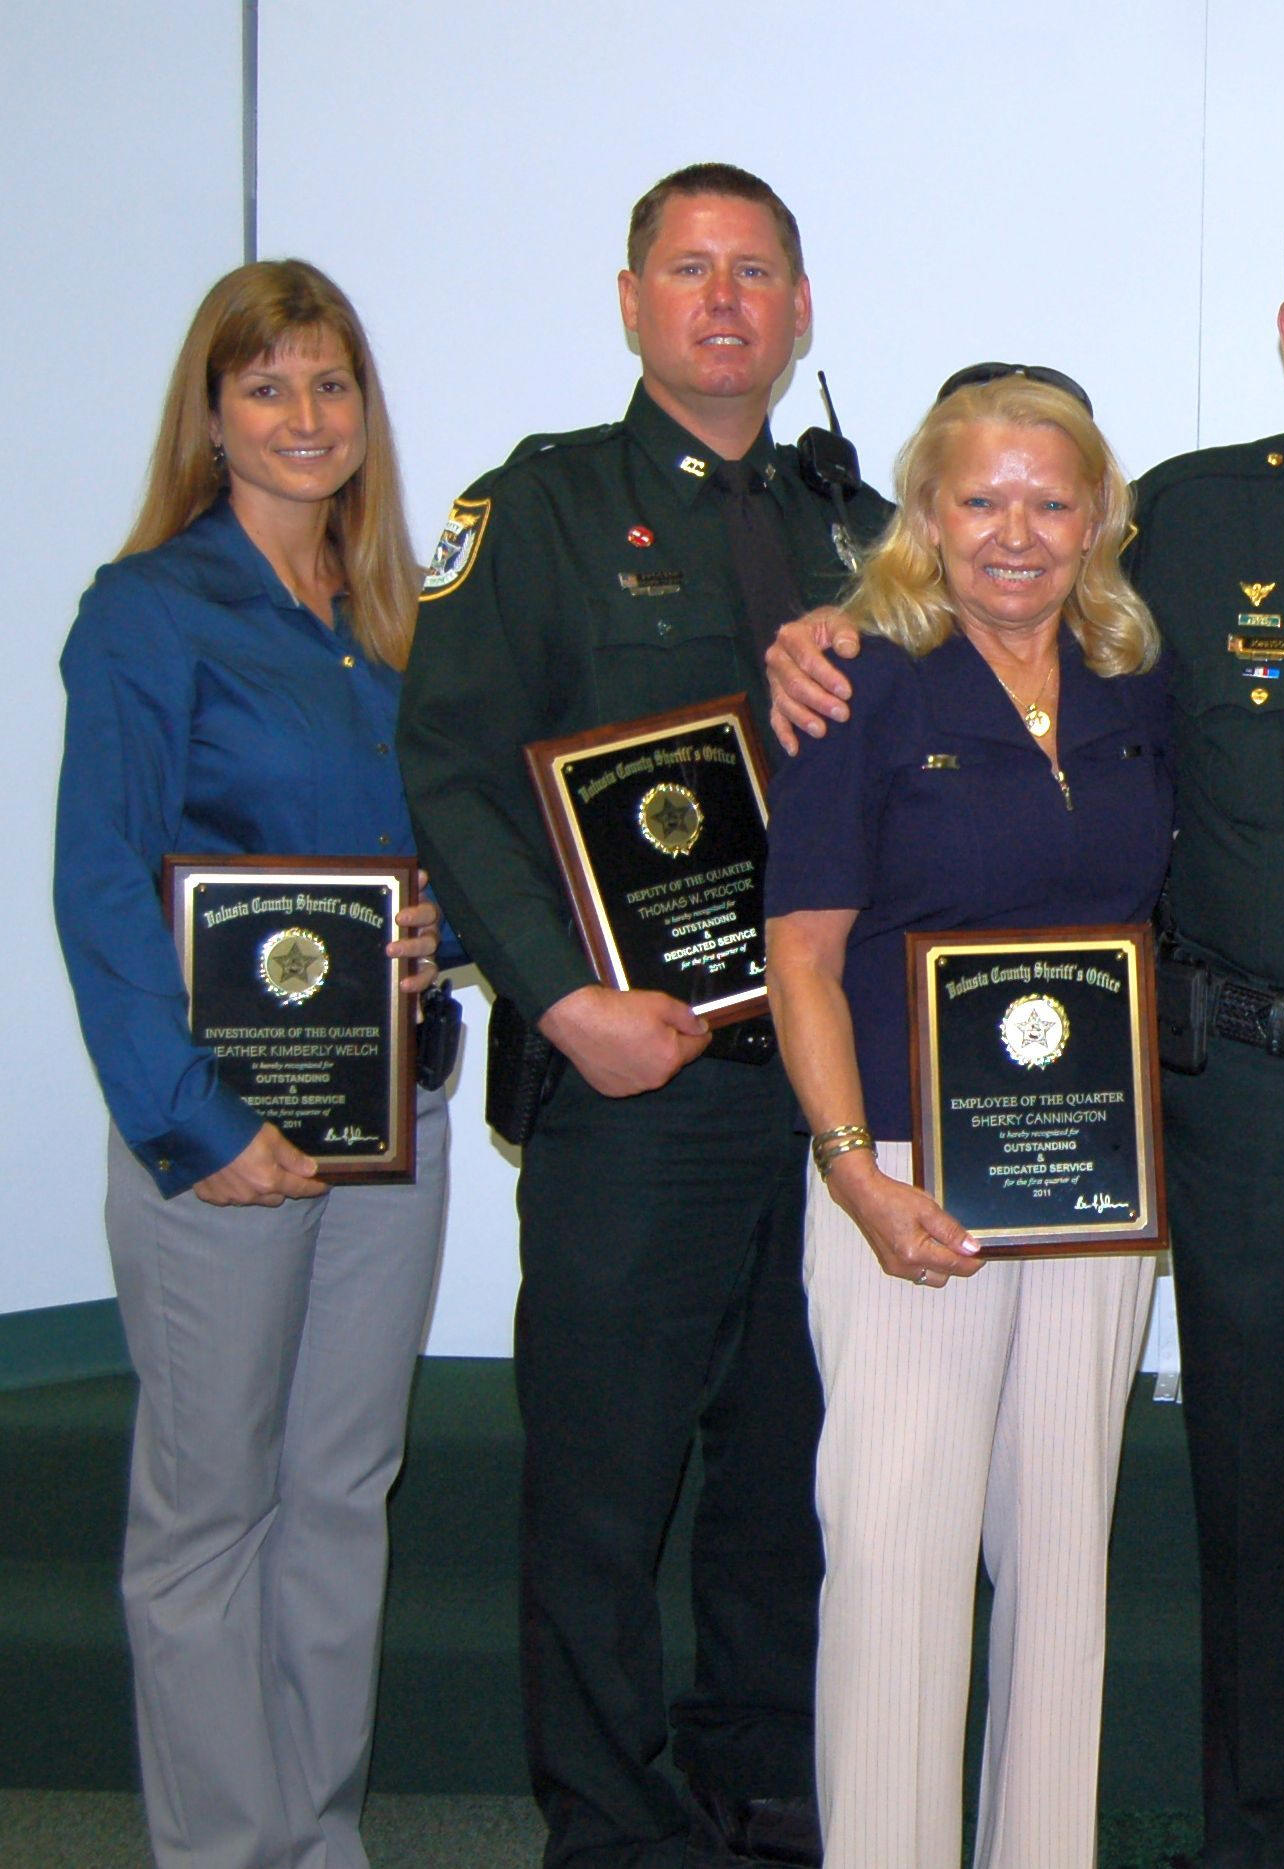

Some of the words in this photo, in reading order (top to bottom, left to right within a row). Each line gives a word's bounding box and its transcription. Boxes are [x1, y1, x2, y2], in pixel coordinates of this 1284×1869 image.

[703, 744, 736, 765] Office
[626, 884, 667, 904] DEPUTY
[669, 880, 682, 892] OF
[684, 874, 705, 887] THE
[706, 861, 754, 882] QUARTER
[638, 897, 688, 920] THOMAS
[688, 893, 702, 904] W.
[704, 878, 754, 900] PROCTOR
[204, 902, 249, 928] Volusia
[252, 896, 293, 914] County
[296, 894, 346, 915] Sheriff's
[350, 902, 384, 929] Office
[672, 912, 737, 937] OUTSTANDING
[664, 940, 716, 962] DEDICATED
[718, 928, 758, 946] SERVICE
[945, 972, 989, 999] Volusia
[991, 964, 1031, 984] County
[1034, 961, 1083, 983] Sheriff's
[1086, 966, 1120, 994] Office
[206, 1028, 285, 1038] INVESTIGATOR
[288, 1028, 301, 1038] OF
[304, 1028, 326, 1038] THE
[328, 1027, 380, 1038] QUARTER
[270, 1045, 334, 1056] KIMBERLY
[336, 1044, 378, 1056] WELCH
[256, 1074, 330, 1083] OUTSTANDING
[289, 1084, 298, 1094] &
[302, 1095, 345, 1104] SERVICE
[951, 1096, 1018, 1109] EMPLOYEE
[1020, 1096, 1036, 1106] OF
[1040, 1094, 1063, 1106] THE
[1066, 1092, 1124, 1106] QUARTER
[284, 1120, 301, 1128] 2011
[972, 1114, 1022, 1128] SHERRY
[1026, 1110, 1106, 1125] CANNINGTON
[1007, 1130, 1030, 1138] hereby
[1004, 1141, 1076, 1152] OUTSTANDING
[1037, 1154, 1044, 1162] &
[989, 1164, 1046, 1176] DEDICATED
[1050, 1162, 1094, 1172] SERVICE
[1003, 1178, 1014, 1188] for
[1071, 1176, 1080, 1184] of
[1033, 1190, 1051, 1198] 2011
